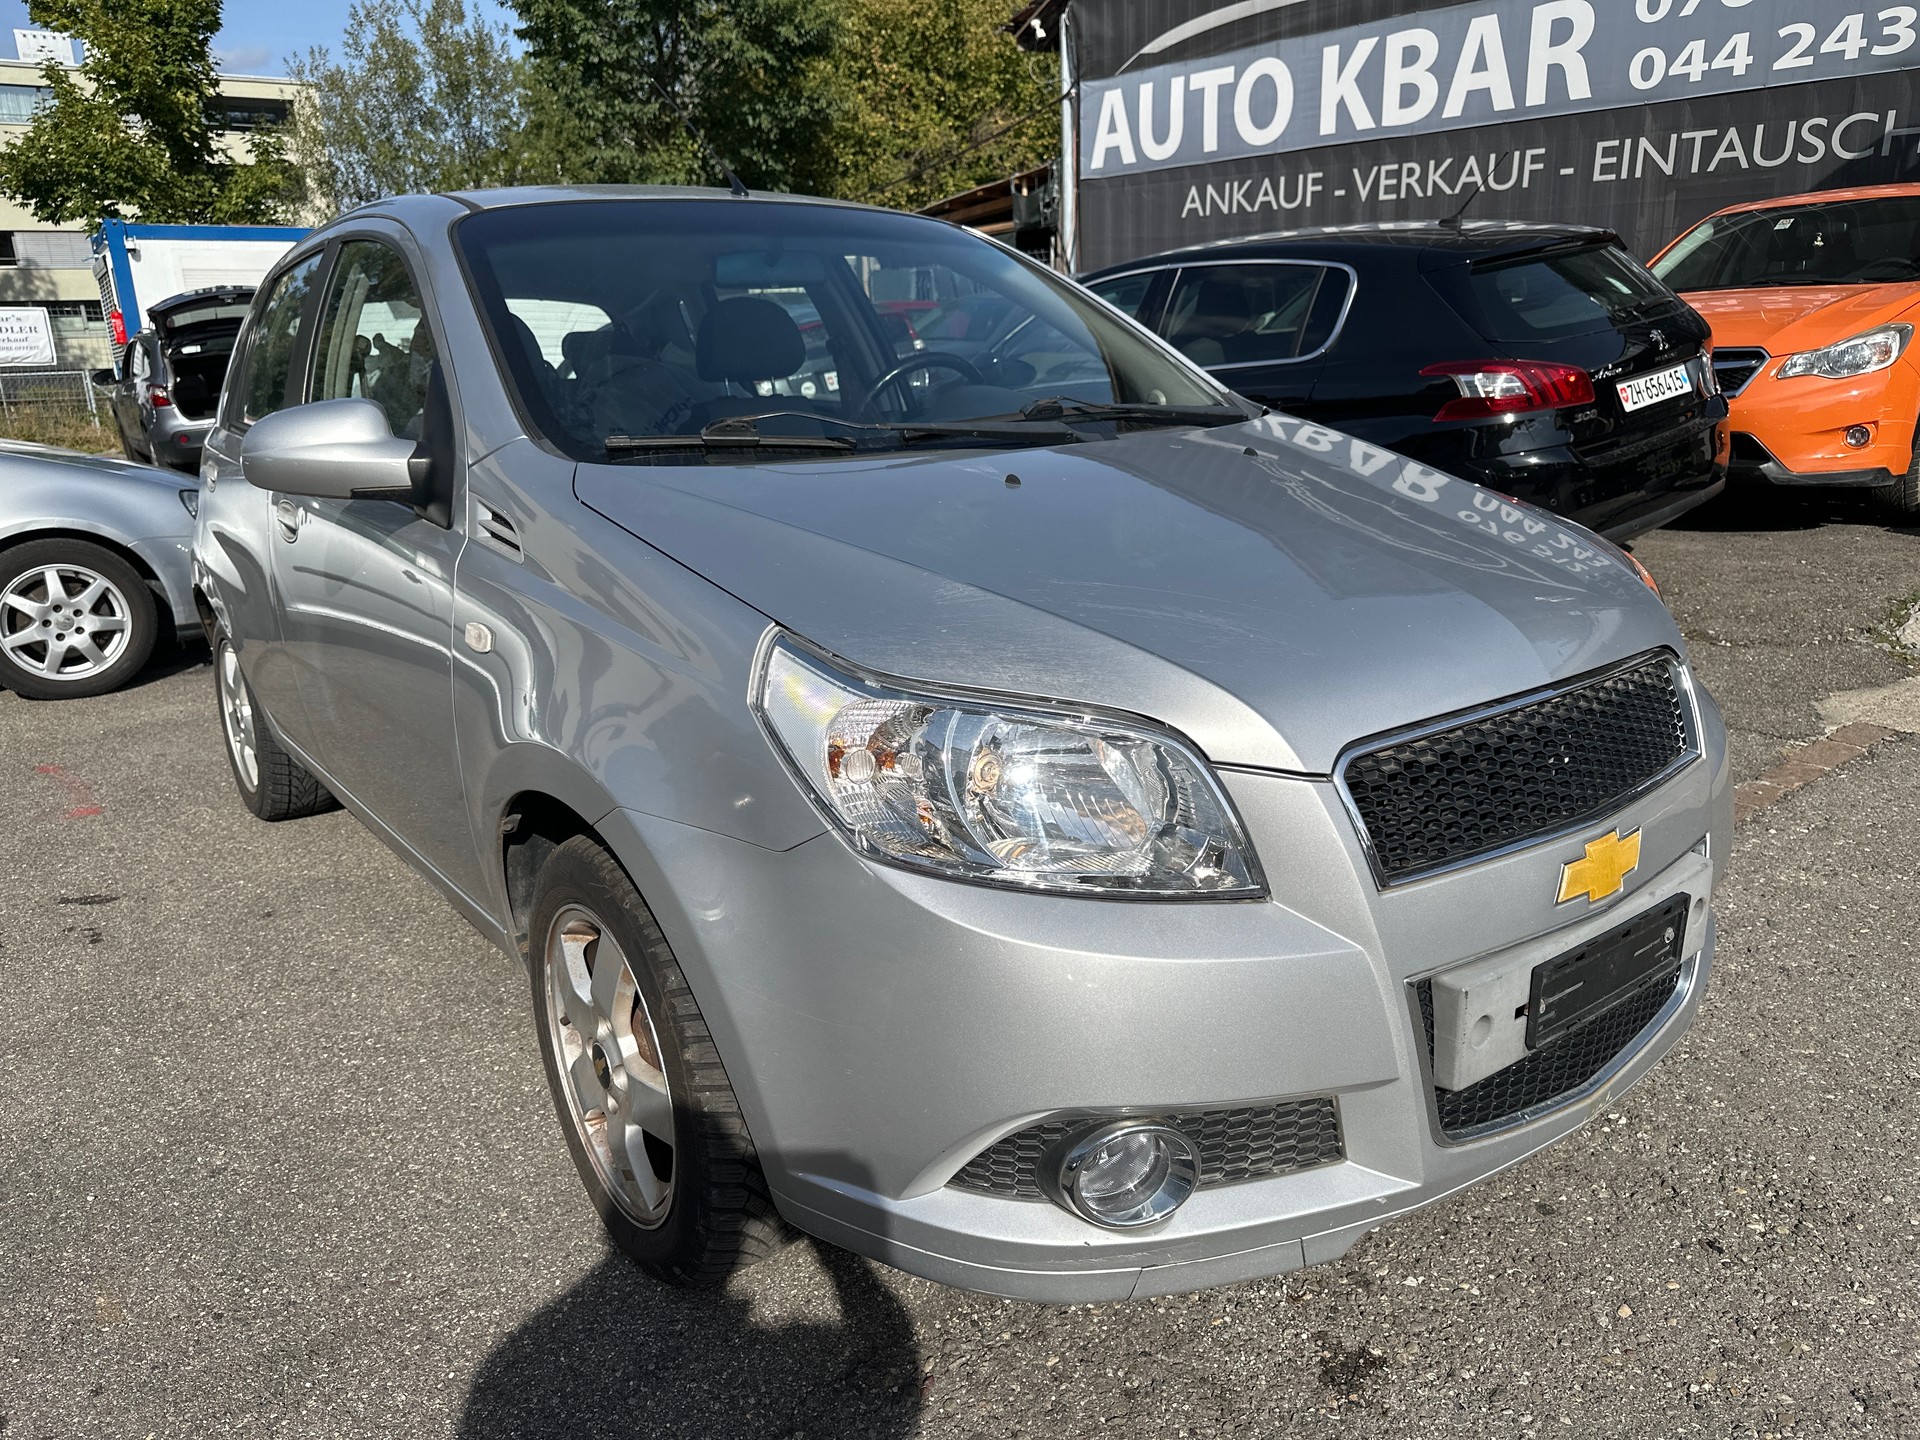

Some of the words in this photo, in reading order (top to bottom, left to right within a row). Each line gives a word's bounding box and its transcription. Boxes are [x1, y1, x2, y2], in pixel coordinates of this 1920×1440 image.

[1090, 57, 1294, 169] AUTO
[1319, 0, 1596, 136] KBAR
[1628, 31, 1753, 90] 044
[1772, 6, 1918, 70] 243
[1181, 171, 1323, 218] ANKAUF
[1353, 148, 1546, 202] VERKAUF
